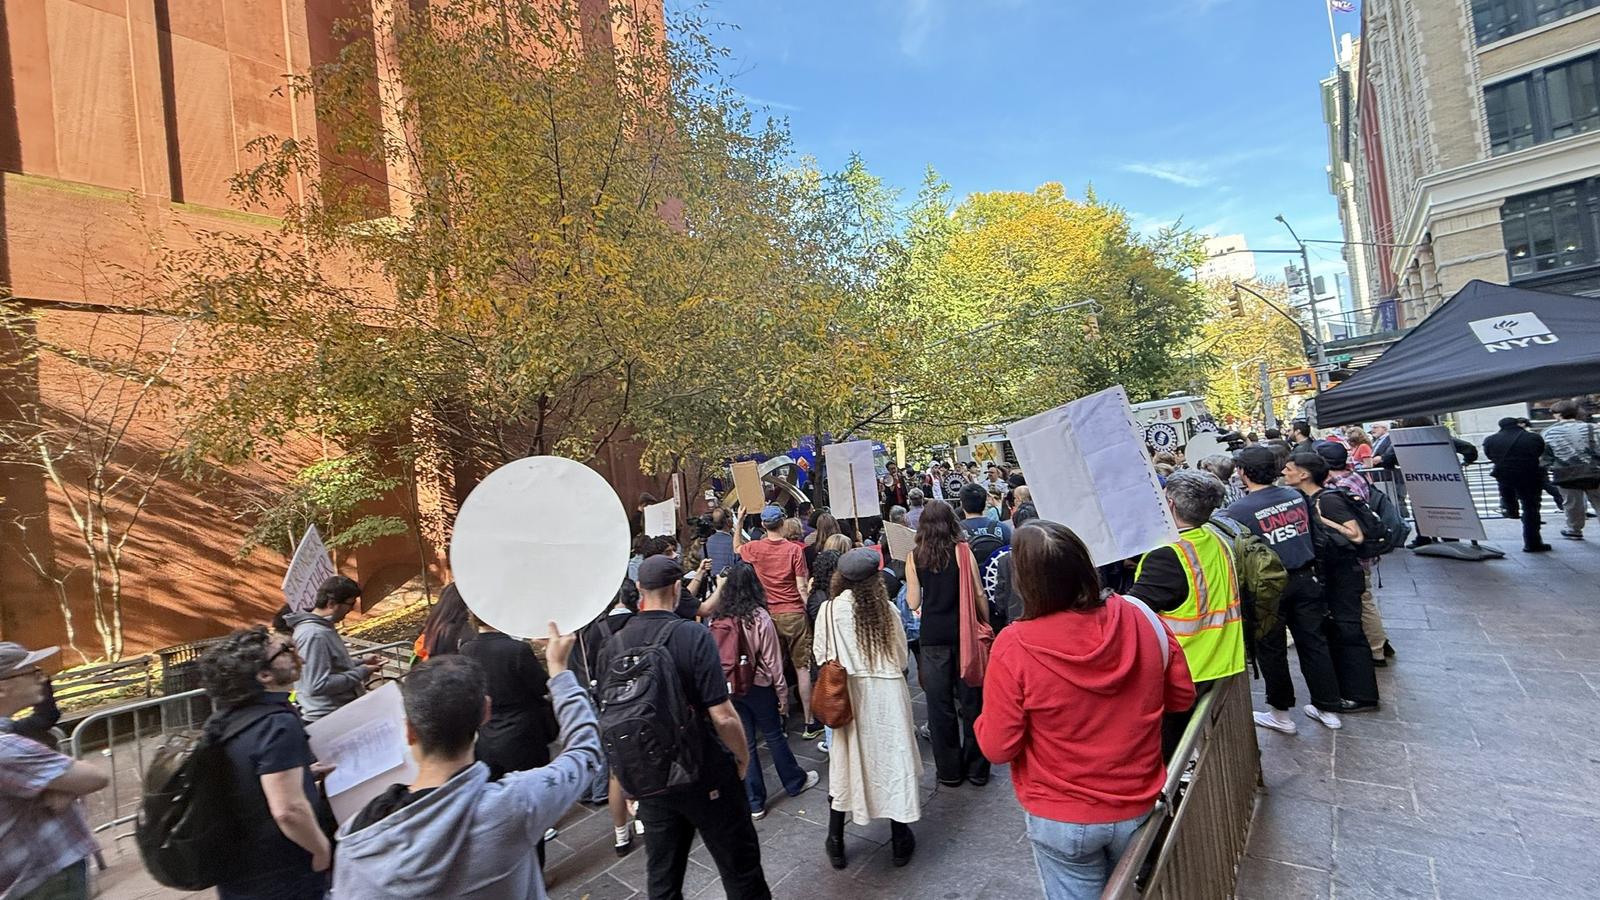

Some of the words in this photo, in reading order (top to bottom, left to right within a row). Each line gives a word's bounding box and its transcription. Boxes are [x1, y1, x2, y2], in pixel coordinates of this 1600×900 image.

[1484, 334, 1559, 353] NYU
[1405, 473, 1461, 482] ENTRANCE
[1259, 506, 1308, 533] UNION
[1263, 524, 1297, 545] YES
